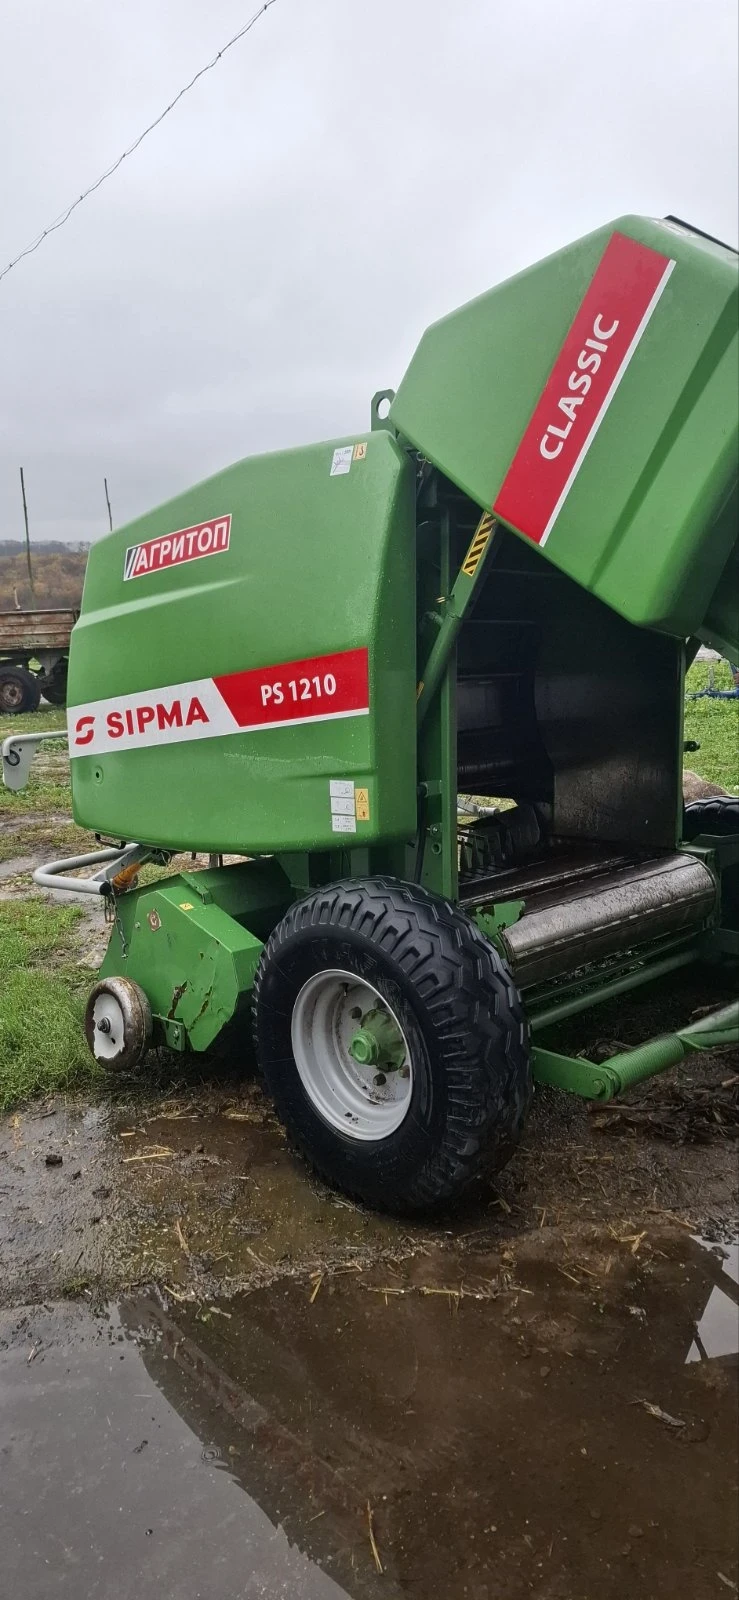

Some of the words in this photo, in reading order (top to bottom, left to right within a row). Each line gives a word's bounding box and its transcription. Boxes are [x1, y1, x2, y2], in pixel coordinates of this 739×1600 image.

[539, 313, 620, 460] CLASSIC
[135, 521, 228, 572] АГРИТОП
[106, 696, 210, 739] SIPMA
[260, 682, 284, 706] PS
[288, 673, 337, 702] 1210
